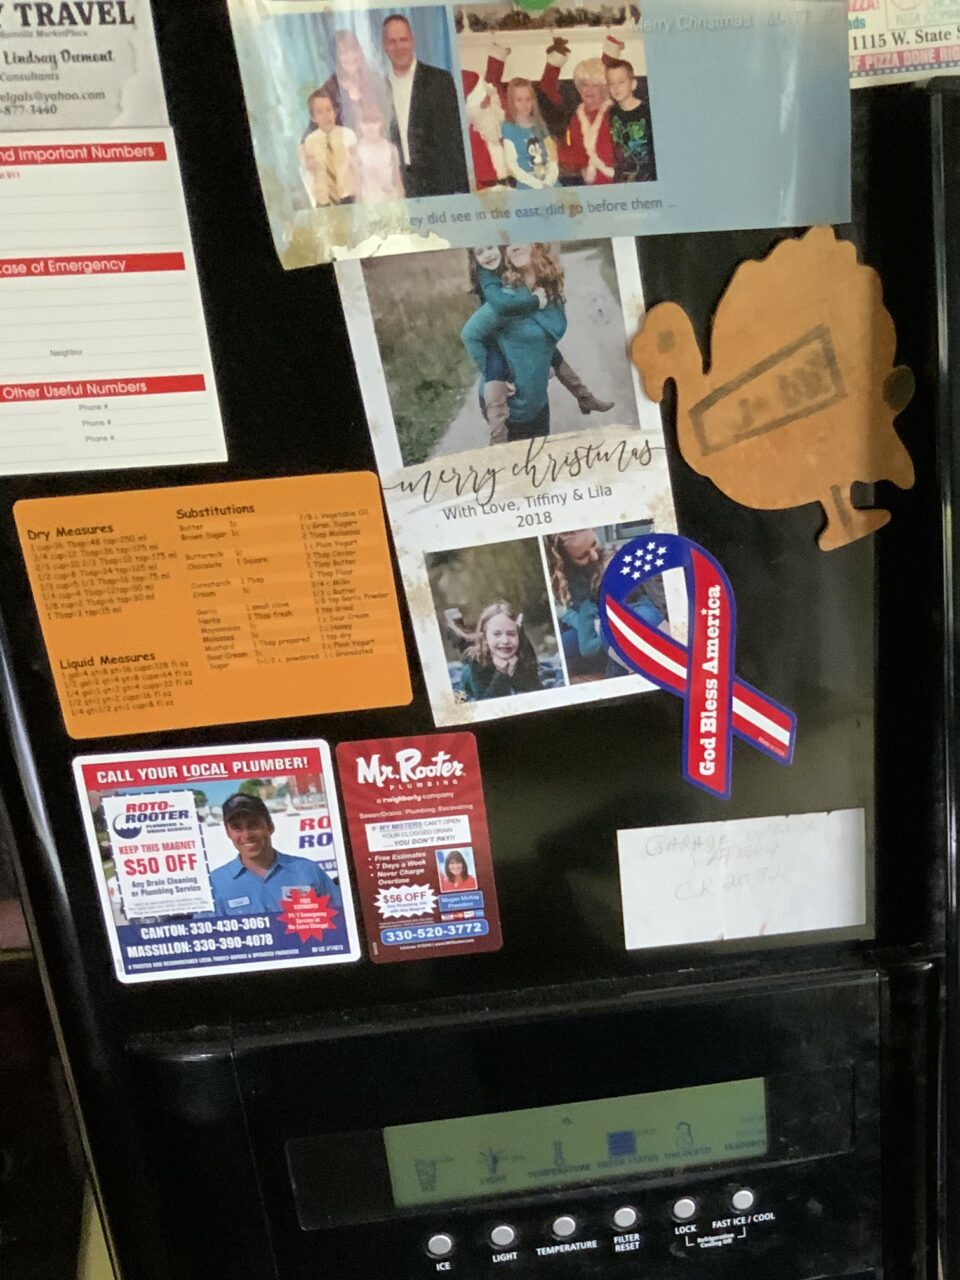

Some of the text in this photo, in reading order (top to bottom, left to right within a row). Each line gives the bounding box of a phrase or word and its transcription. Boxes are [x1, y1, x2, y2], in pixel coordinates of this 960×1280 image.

[14, 1, 136, 27] TRAVEL
[852, 33, 887, 50] 1115
[891, 31, 910, 46] W.
[915, 28, 952, 44] State
[3, 49, 115, 70] Lindsay Dumont
[865, 53, 899, 69] PIZZA
[904, 48, 936, 65] DONE
[0, 72, 60, 81] Consultants
[19, 144, 155, 163] Important Numbers
[427, 197, 663, 224] did see in the did go before them
[31, 260, 126, 275] of Emergency
[3, 381, 147, 399] Other Useful Numbers
[380, 436, 668, 506] merry christmas
[442, 484, 613, 521] With Love, Tiffiny & Lila
[176, 504, 255, 519] Substitutions
[516, 511, 553, 529] 2018
[27, 524, 114, 541] Dry Measures
[60, 652, 156, 670] Liquid Measures
[699, 584, 721, 776] God Bless America
[97, 756, 309, 783] CALL YOUR LOCAL PLUMBER!
[356, 748, 464, 787] Mr. Rooter
[390, 779, 458, 790] PLUMBING
[126, 801, 175, 813] ROTO-
[125, 810, 190, 824] ROOTER
[119, 840, 196, 855] KEEP THIS MAGNET
[392, 852, 427, 860] Estimates
[124, 853, 198, 876] $50 OFF
[132, 881, 144, 889] Any
[167, 877, 198, 885] Cleaning
[140, 888, 174, 896] Plumbing
[141, 917, 270, 940] CANTON: 330-430-3061
[387, 922, 482, 942] 330-520-3772
[127, 943, 192, 958] MASSILLON:
[194, 934, 273, 952] 330-390-4078
[712, 1219, 731, 1229] FAST
[732, 1216, 746, 1225] ICE
[753, 1212, 776, 1222] COOL
[674, 1224, 697, 1235] LOCK
[613, 1233, 640, 1244] FILTER
[614, 1242, 640, 1252] RESET
[536, 1240, 598, 1256] TEMPERATURE
[492, 1252, 518, 1263] LIGHT
[436, 1262, 451, 1271] ICE
